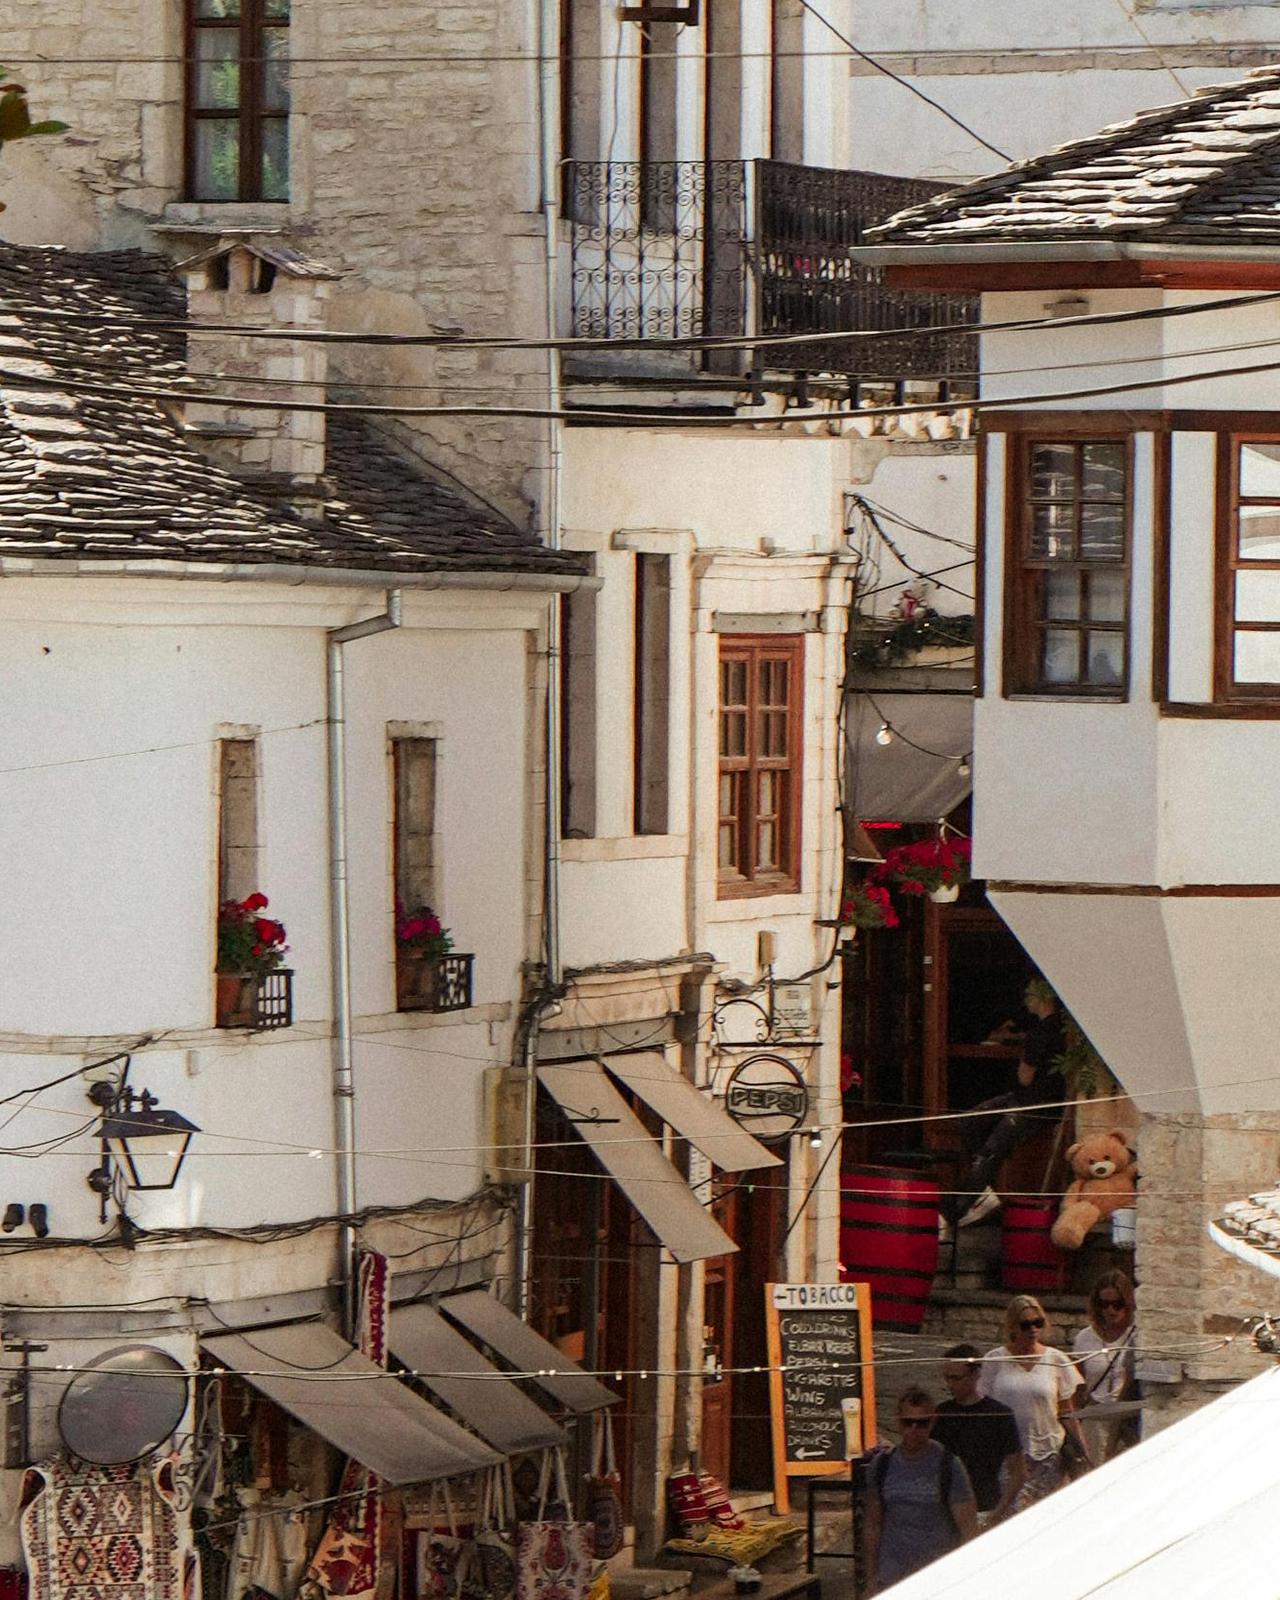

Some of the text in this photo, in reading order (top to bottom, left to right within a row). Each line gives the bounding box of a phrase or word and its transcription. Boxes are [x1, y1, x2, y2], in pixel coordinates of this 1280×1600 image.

[731, 1087, 805, 1113] PEPSI
[785, 1285, 856, 1306] TOBACCO
[785, 1387, 825, 1405] WINE
